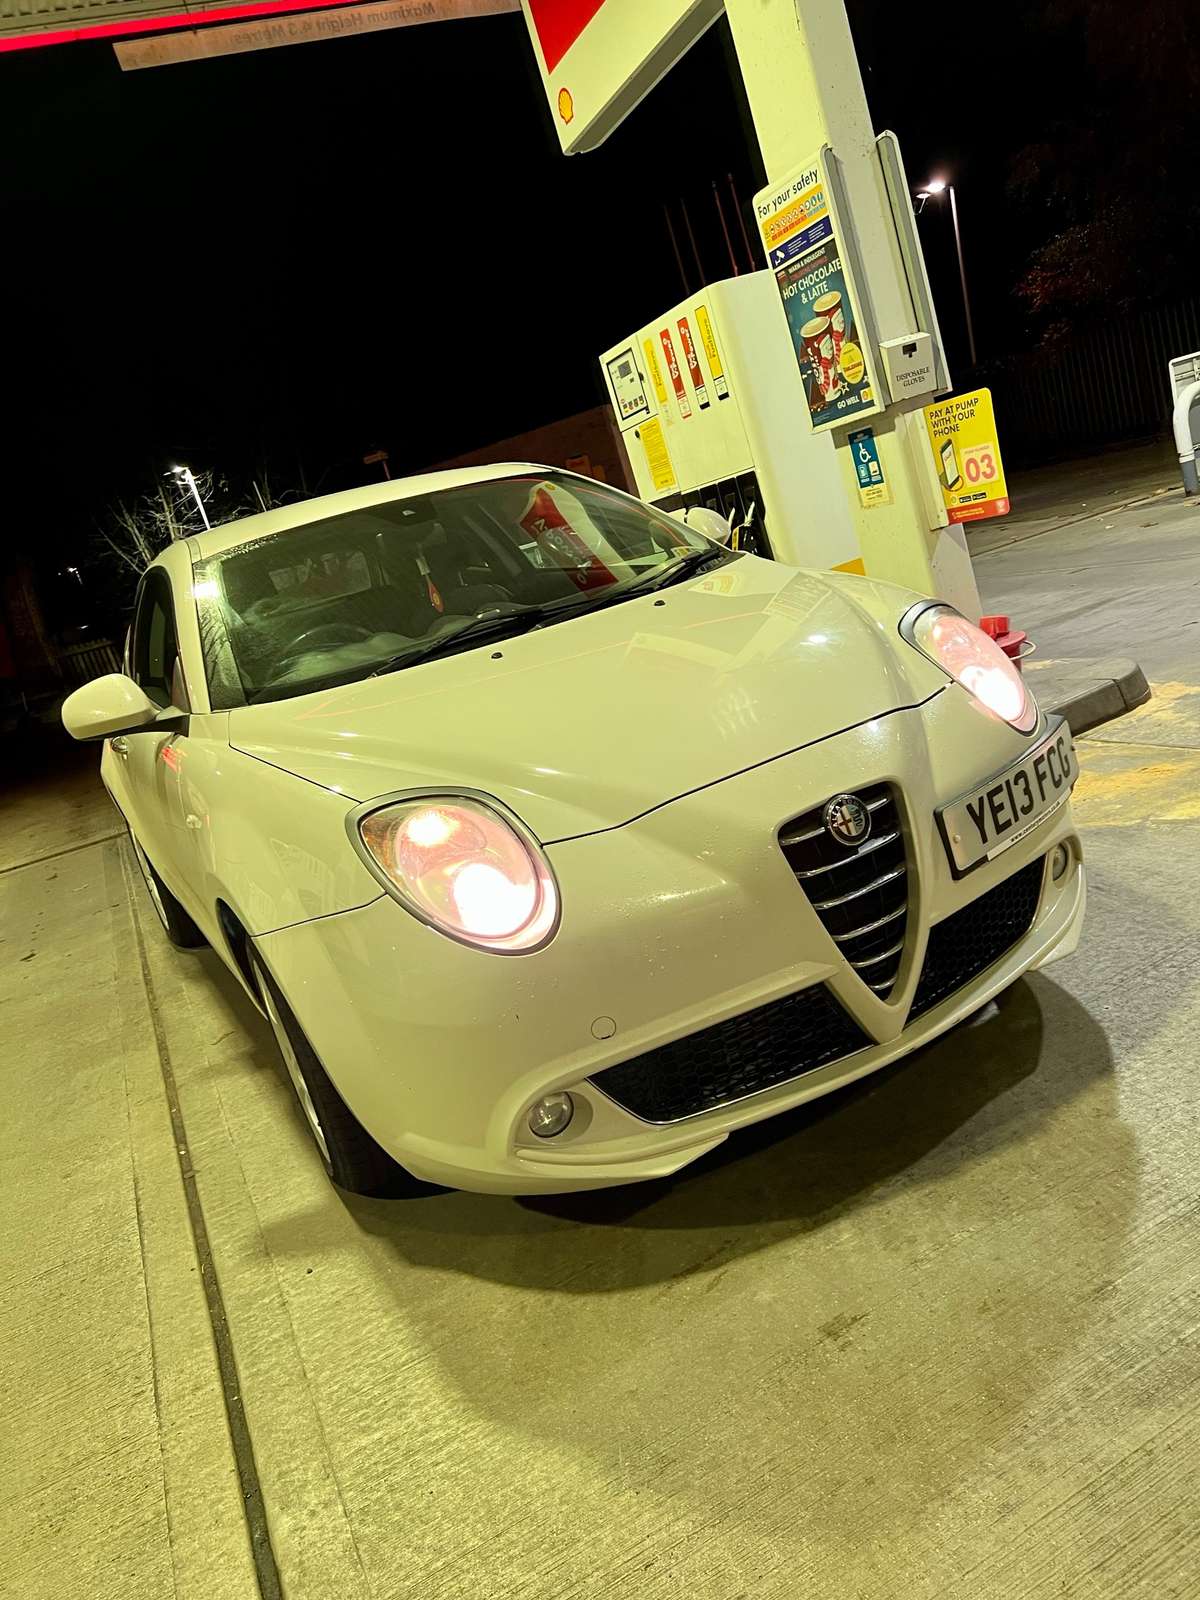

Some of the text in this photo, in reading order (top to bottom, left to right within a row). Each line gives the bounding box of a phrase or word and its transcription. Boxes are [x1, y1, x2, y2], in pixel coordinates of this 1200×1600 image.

[757, 169, 818, 219] For your safety
[782, 283, 798, 300] HOT
[798, 258, 842, 291] CHOCOLATE
[801, 281, 829, 304] & LATTE
[896, 366, 929, 382] DISPOSABLE
[903, 376, 925, 387] GLOVES
[837, 400, 847, 409] GO
[929, 398, 979, 420] PAY AT PUMP
[931, 409, 976, 429] WITH YOUR
[933, 424, 960, 438] PHONE
[965, 453, 996, 482] 03
[965, 769, 1035, 845] YE13
[1033, 736, 1071, 802] FCG
